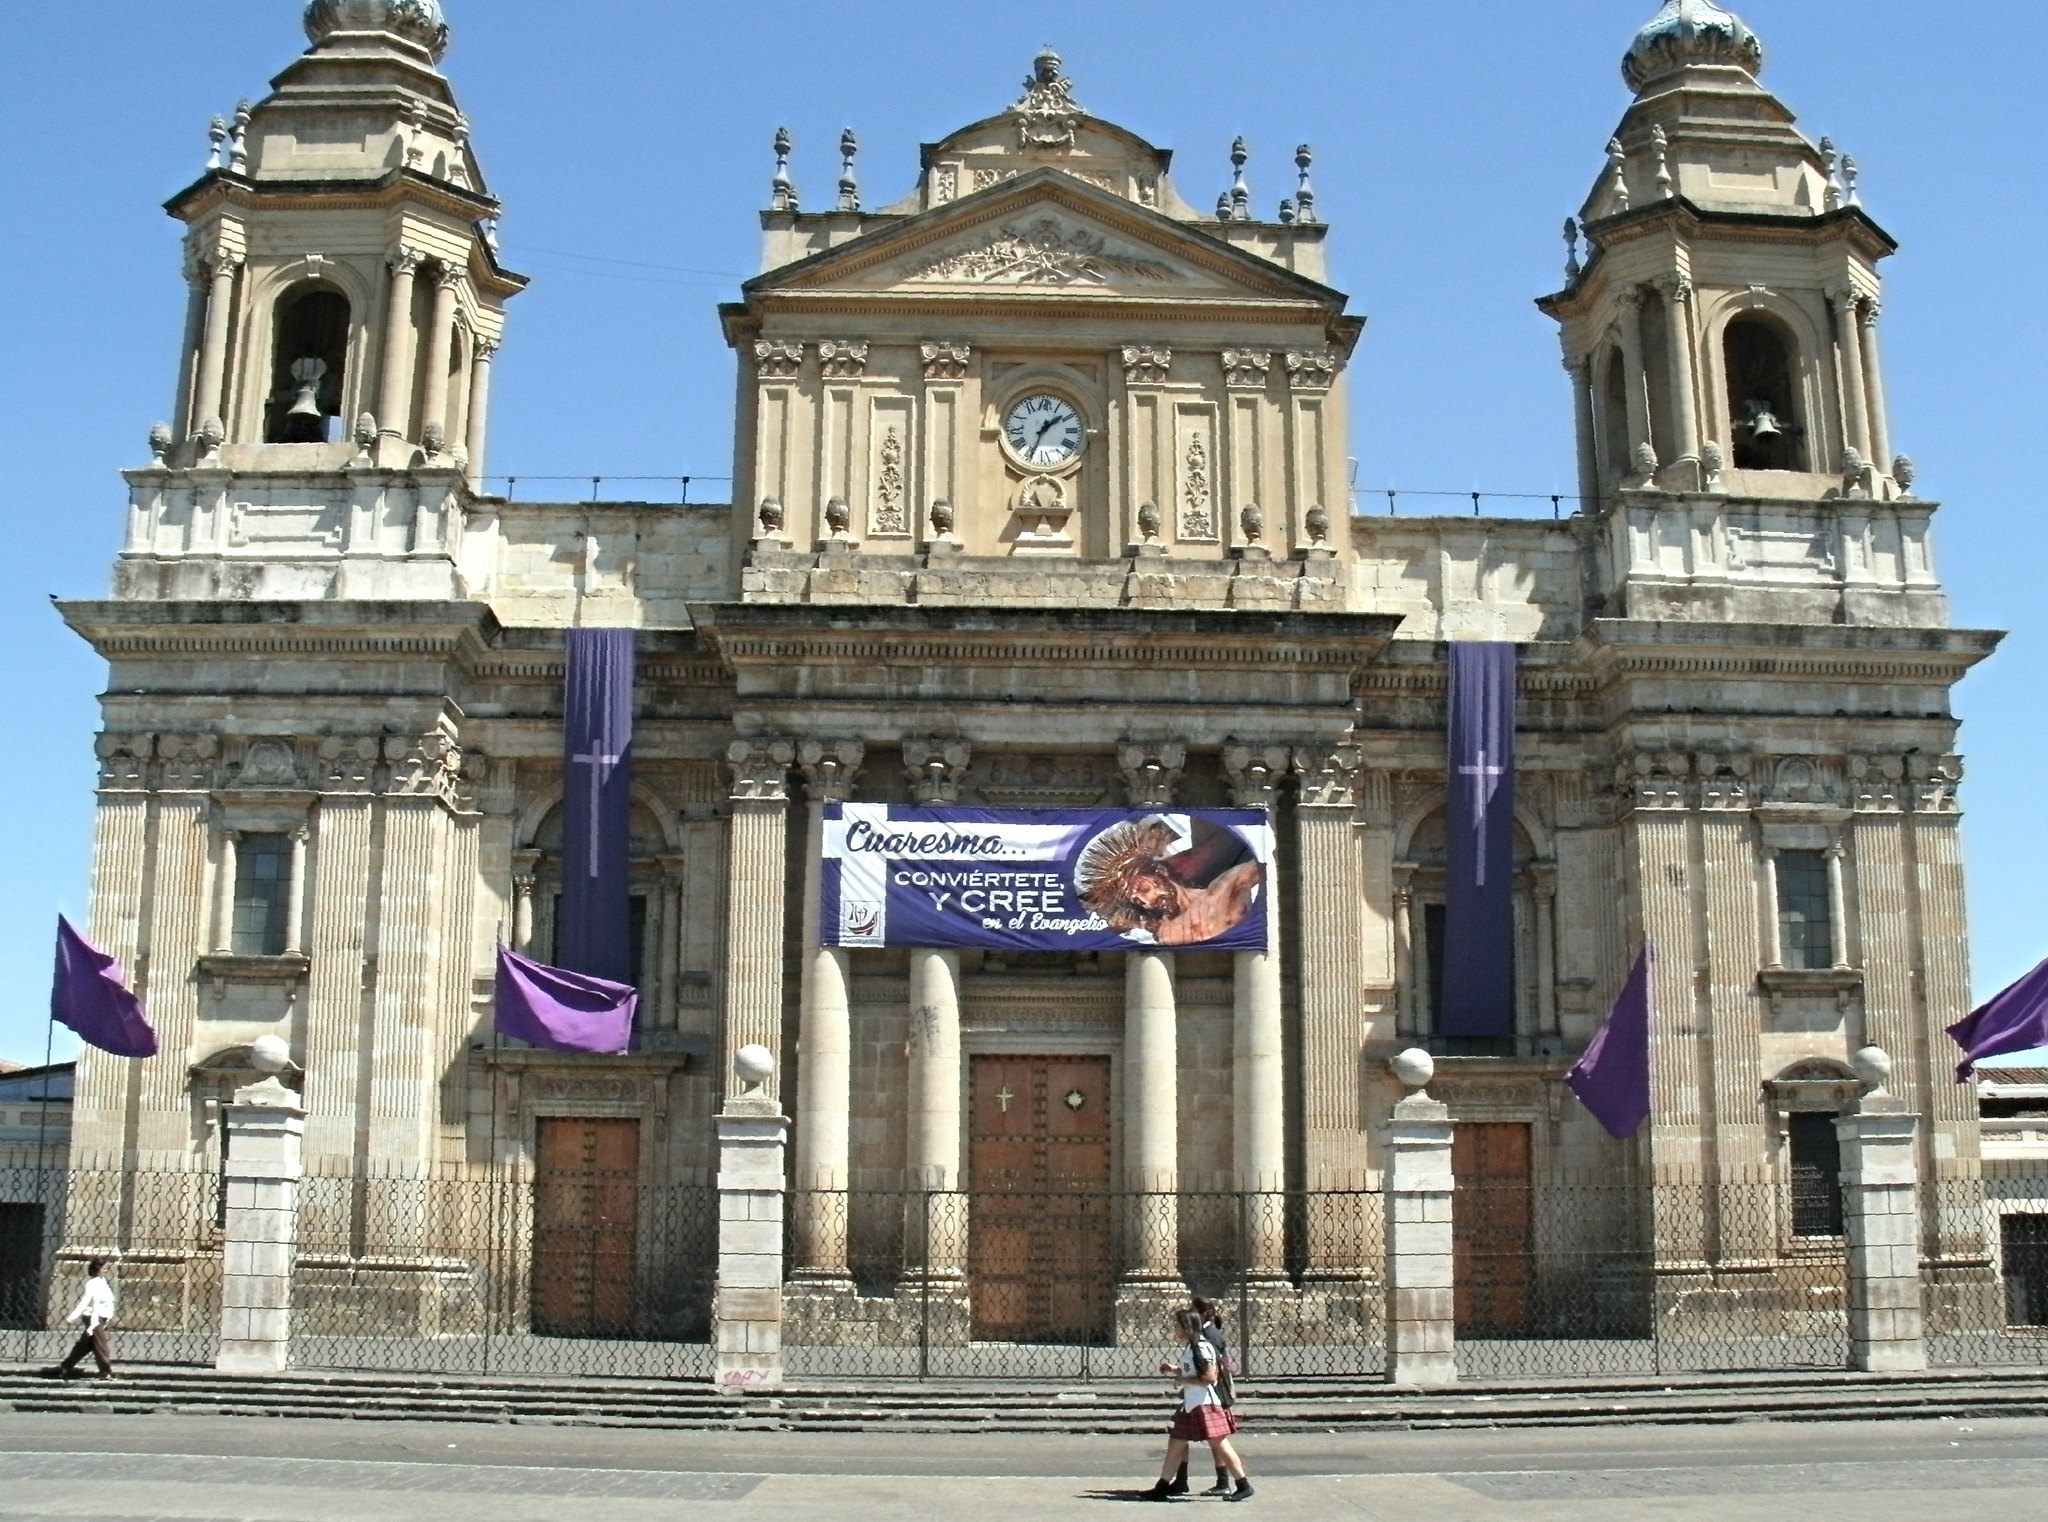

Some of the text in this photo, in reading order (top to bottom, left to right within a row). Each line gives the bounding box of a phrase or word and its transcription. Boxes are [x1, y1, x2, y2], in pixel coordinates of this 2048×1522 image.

[1061, 413, 1075, 422] II
[894, 869, 1065, 889] CONVIÉRTETE,
[928, 889, 1064, 913] Y CREE
[982, 909, 1109, 935] en el Evangelio
